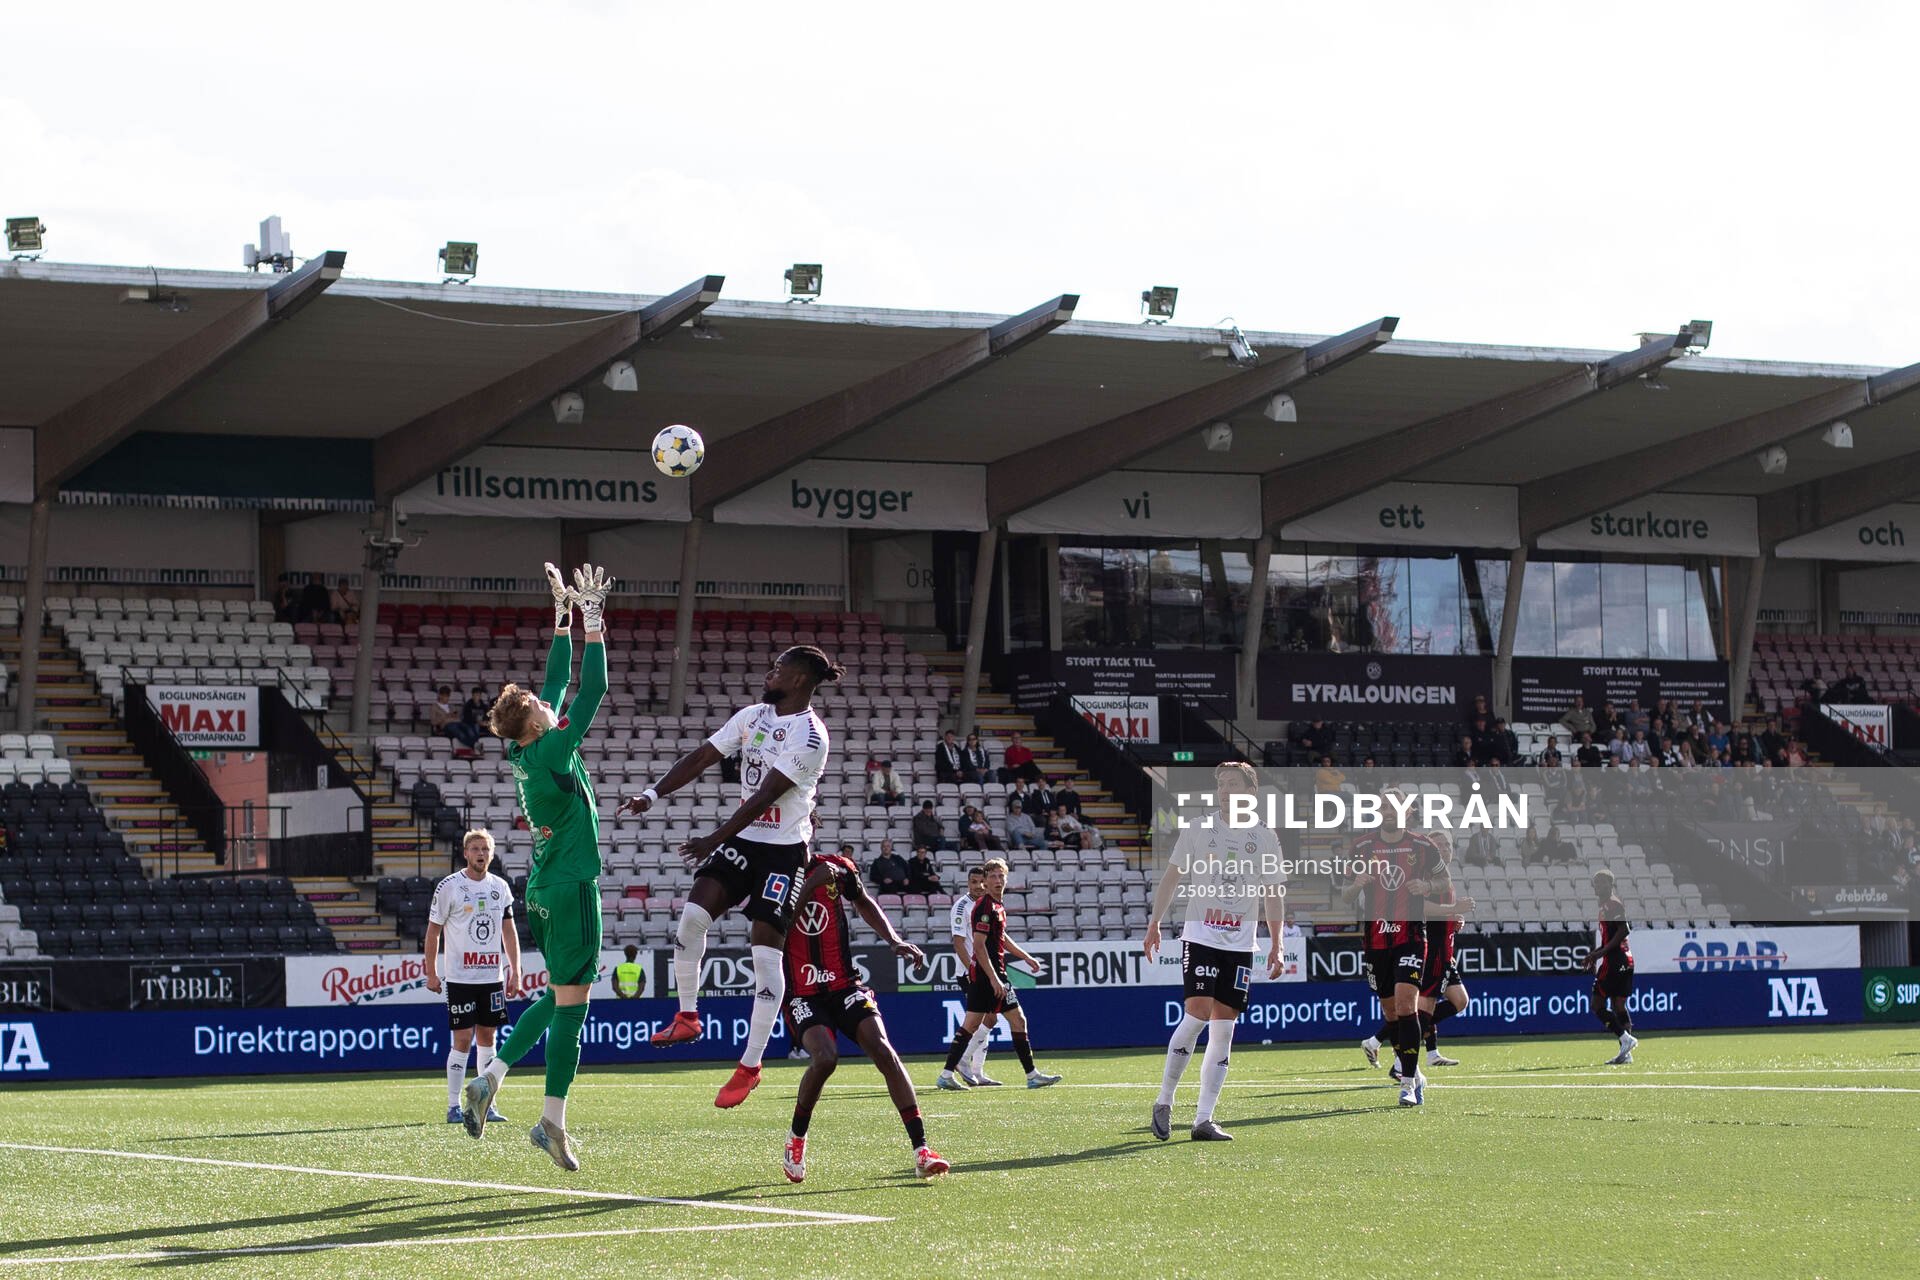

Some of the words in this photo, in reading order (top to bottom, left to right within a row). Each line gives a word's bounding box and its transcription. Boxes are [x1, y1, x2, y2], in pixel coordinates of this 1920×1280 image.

[436, 466, 658, 503] Tillsammans
[791, 479, 912, 519] bygger
[1123, 491, 1150, 519] vi
[1379, 504, 1425, 529] ett
[1590, 511, 1709, 540] starkare
[1858, 520, 1905, 546] och
[1065, 657, 1101, 666] STORT
[1104, 657, 1130, 667] TACK
[1133, 657, 1156, 667] TILL
[1582, 666, 1614, 676] STORT
[1616, 667, 1639, 676] TACK
[1641, 667, 1660, 676] TILL
[160, 690, 246, 701] BOGLUNDSÄNGEN
[1292, 684, 1456, 705] EYRALOUNGEN
[161, 703, 246, 732] MAXI
[177, 733, 246, 742] STORMARKNAD
[1376, 918, 1402, 934] Diös
[464, 952, 499, 965] MAXI
[1399, 955, 1423, 969] stc
[1679, 932, 1780, 972] ÖBAB
[800, 964, 837, 986] Diös
[1056, 951, 1147, 985] FRONT
[141, 977, 233, 1001] TYBBLE
[1196, 982, 1204, 990] 32
[1768, 977, 1828, 1017] NA
[1548, 989, 1590, 1016] och
[0, 1022, 49, 1072] A
[194, 1024, 438, 1058] Direktrapporter,
